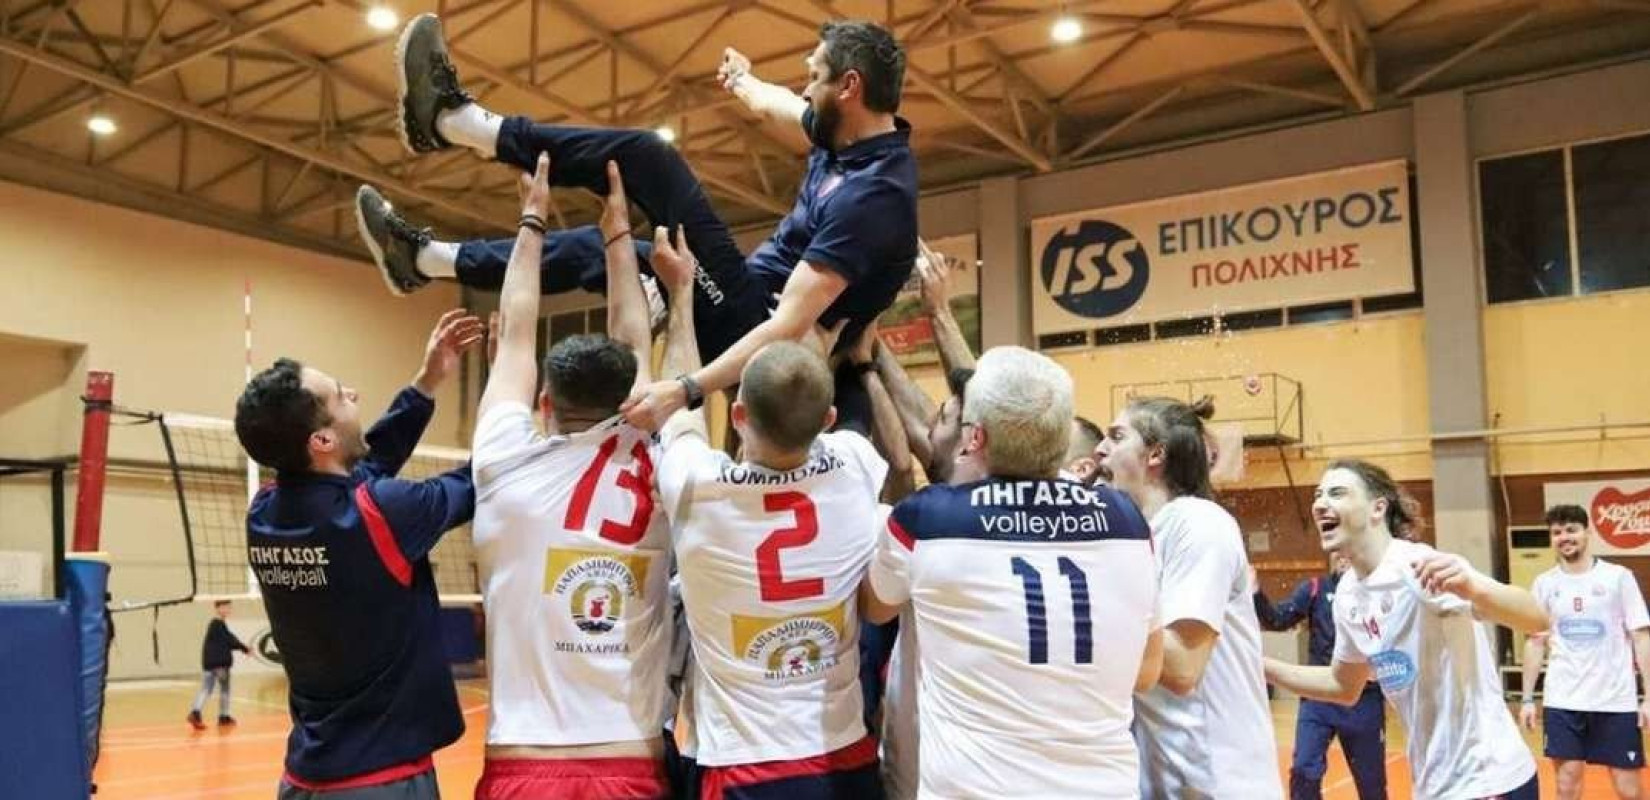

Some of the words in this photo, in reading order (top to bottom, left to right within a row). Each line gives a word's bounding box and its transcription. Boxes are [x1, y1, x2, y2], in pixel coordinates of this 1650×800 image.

[1158, 187, 1402, 256] ΕΠΙΚΟΥΡΟΣ
[1191, 243, 1361, 289] ΠΟΛΙΧΝΗΣ
[563, 433, 654, 546] 13
[756, 491, 824, 602] 2
[980, 510, 1109, 538] volleyball
[249, 546, 330, 565] ΠΗΓΑΣΟΣ
[259, 565, 328, 590] volleyball
[1011, 556, 1093, 664] 11
